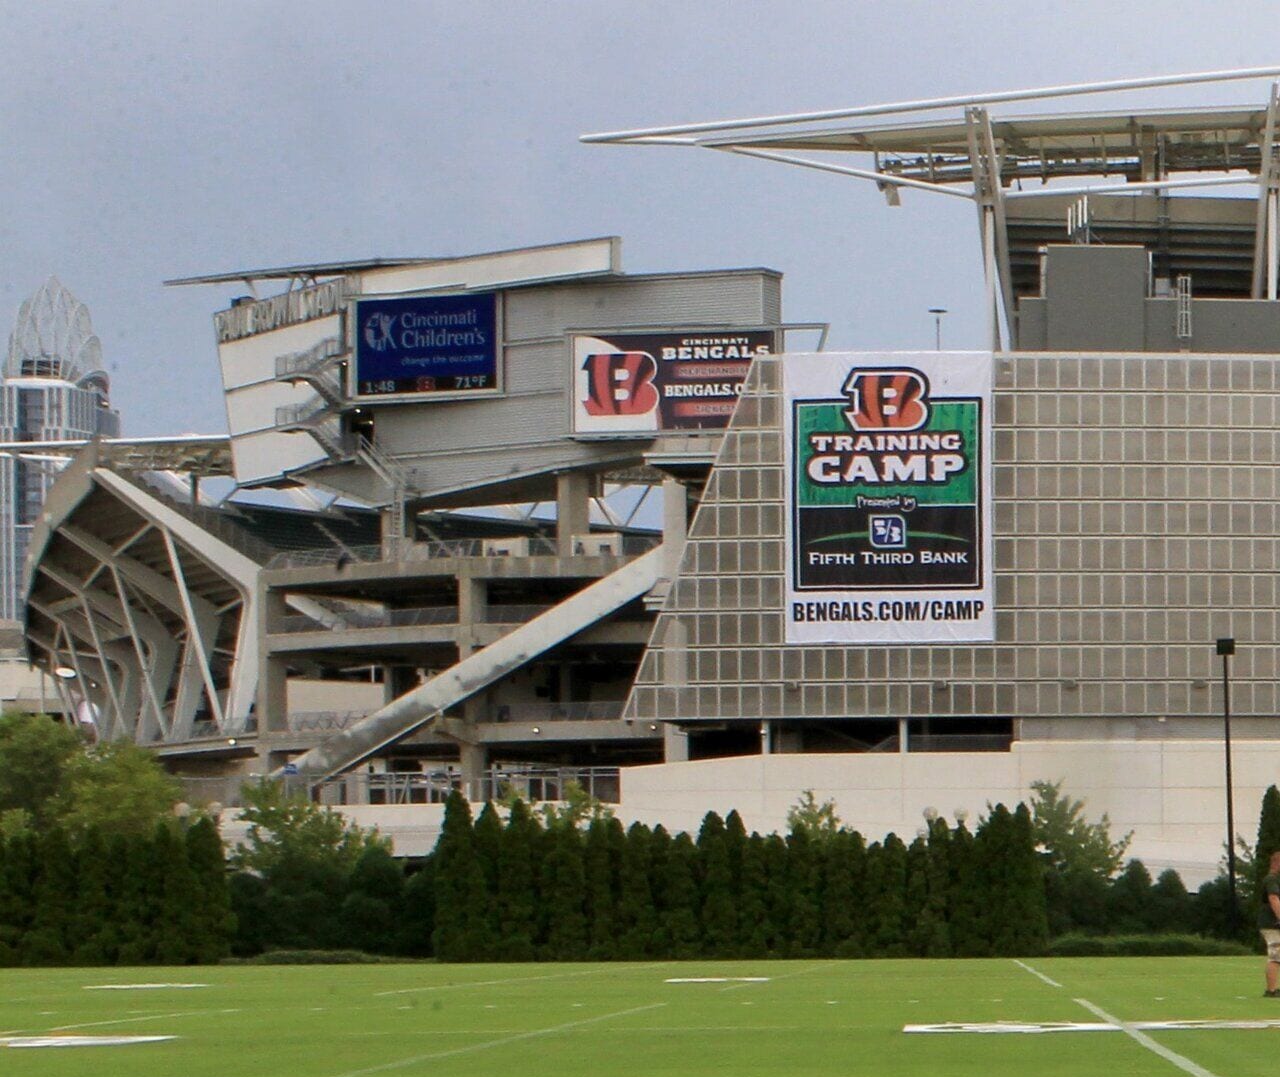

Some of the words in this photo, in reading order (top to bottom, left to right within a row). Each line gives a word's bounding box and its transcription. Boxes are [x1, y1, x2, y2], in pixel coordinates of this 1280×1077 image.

[401, 309, 477, 328] Cincinnati
[401, 328, 486, 348] Children's
[681, 337, 749, 346] CINCINNATI
[661, 345, 770, 360] BENGALS
[366, 380, 395, 393] 1:48
[811, 434, 962, 451] TRAINING
[807, 455, 965, 483] CAMP
[809, 552, 855, 565] FIFTH
[861, 552, 914, 565] THIRD
[920, 551, 968, 564] BANK
[793, 600, 984, 622] BENGALS.COM/CAMP
